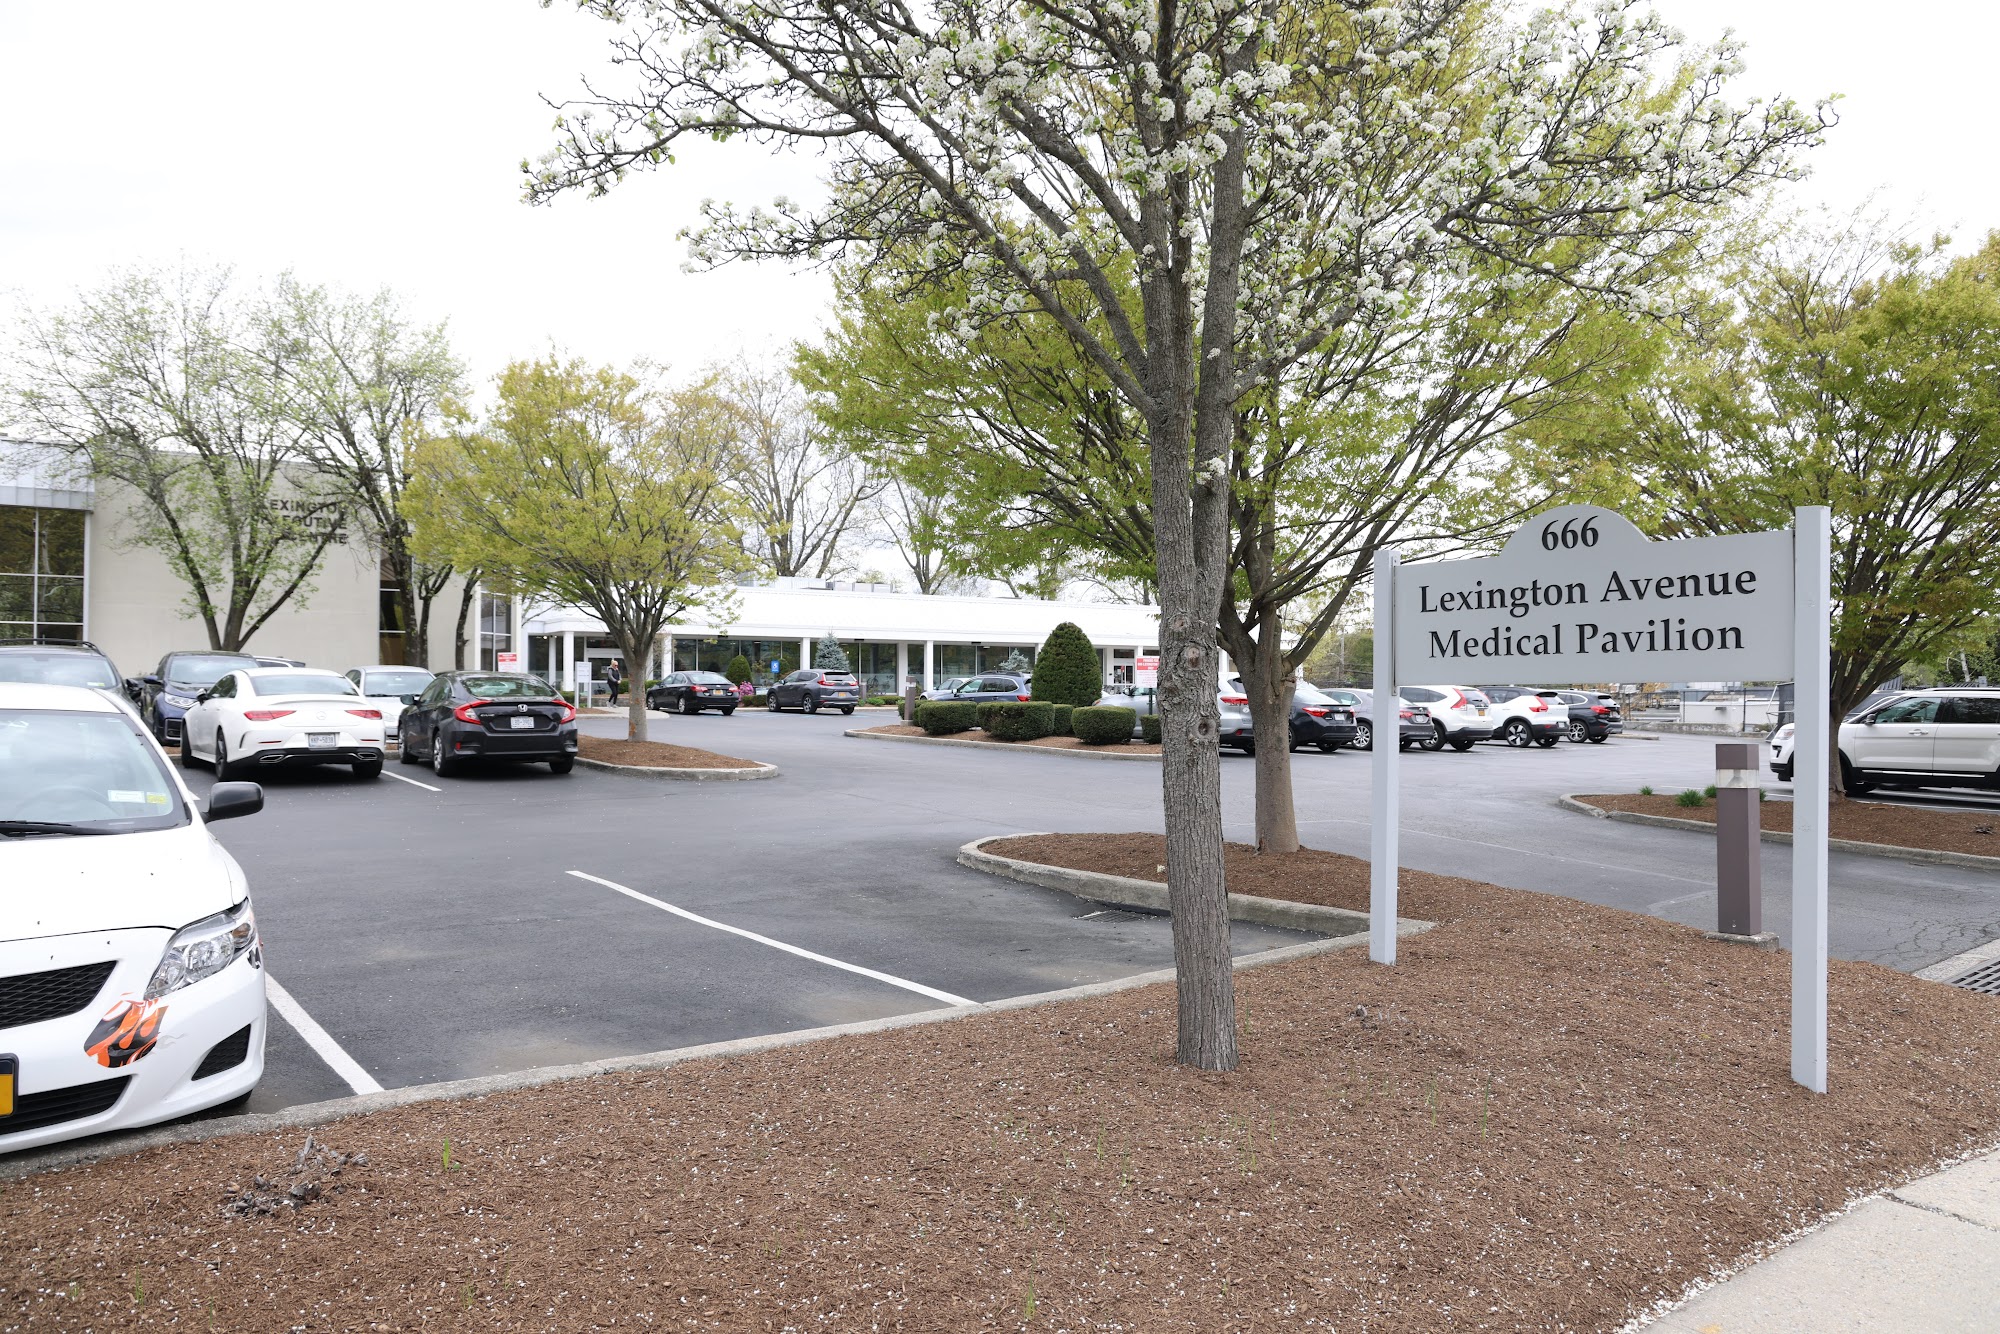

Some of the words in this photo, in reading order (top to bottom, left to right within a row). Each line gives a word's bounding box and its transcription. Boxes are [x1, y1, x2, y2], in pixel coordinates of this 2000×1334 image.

[1541, 515, 1599, 551] 666
[1420, 579, 1589, 618] Lexington
[1600, 569, 1757, 603] Avenue
[1428, 623, 1563, 658] Medical
[1576, 617, 1744, 654] Pavilion
